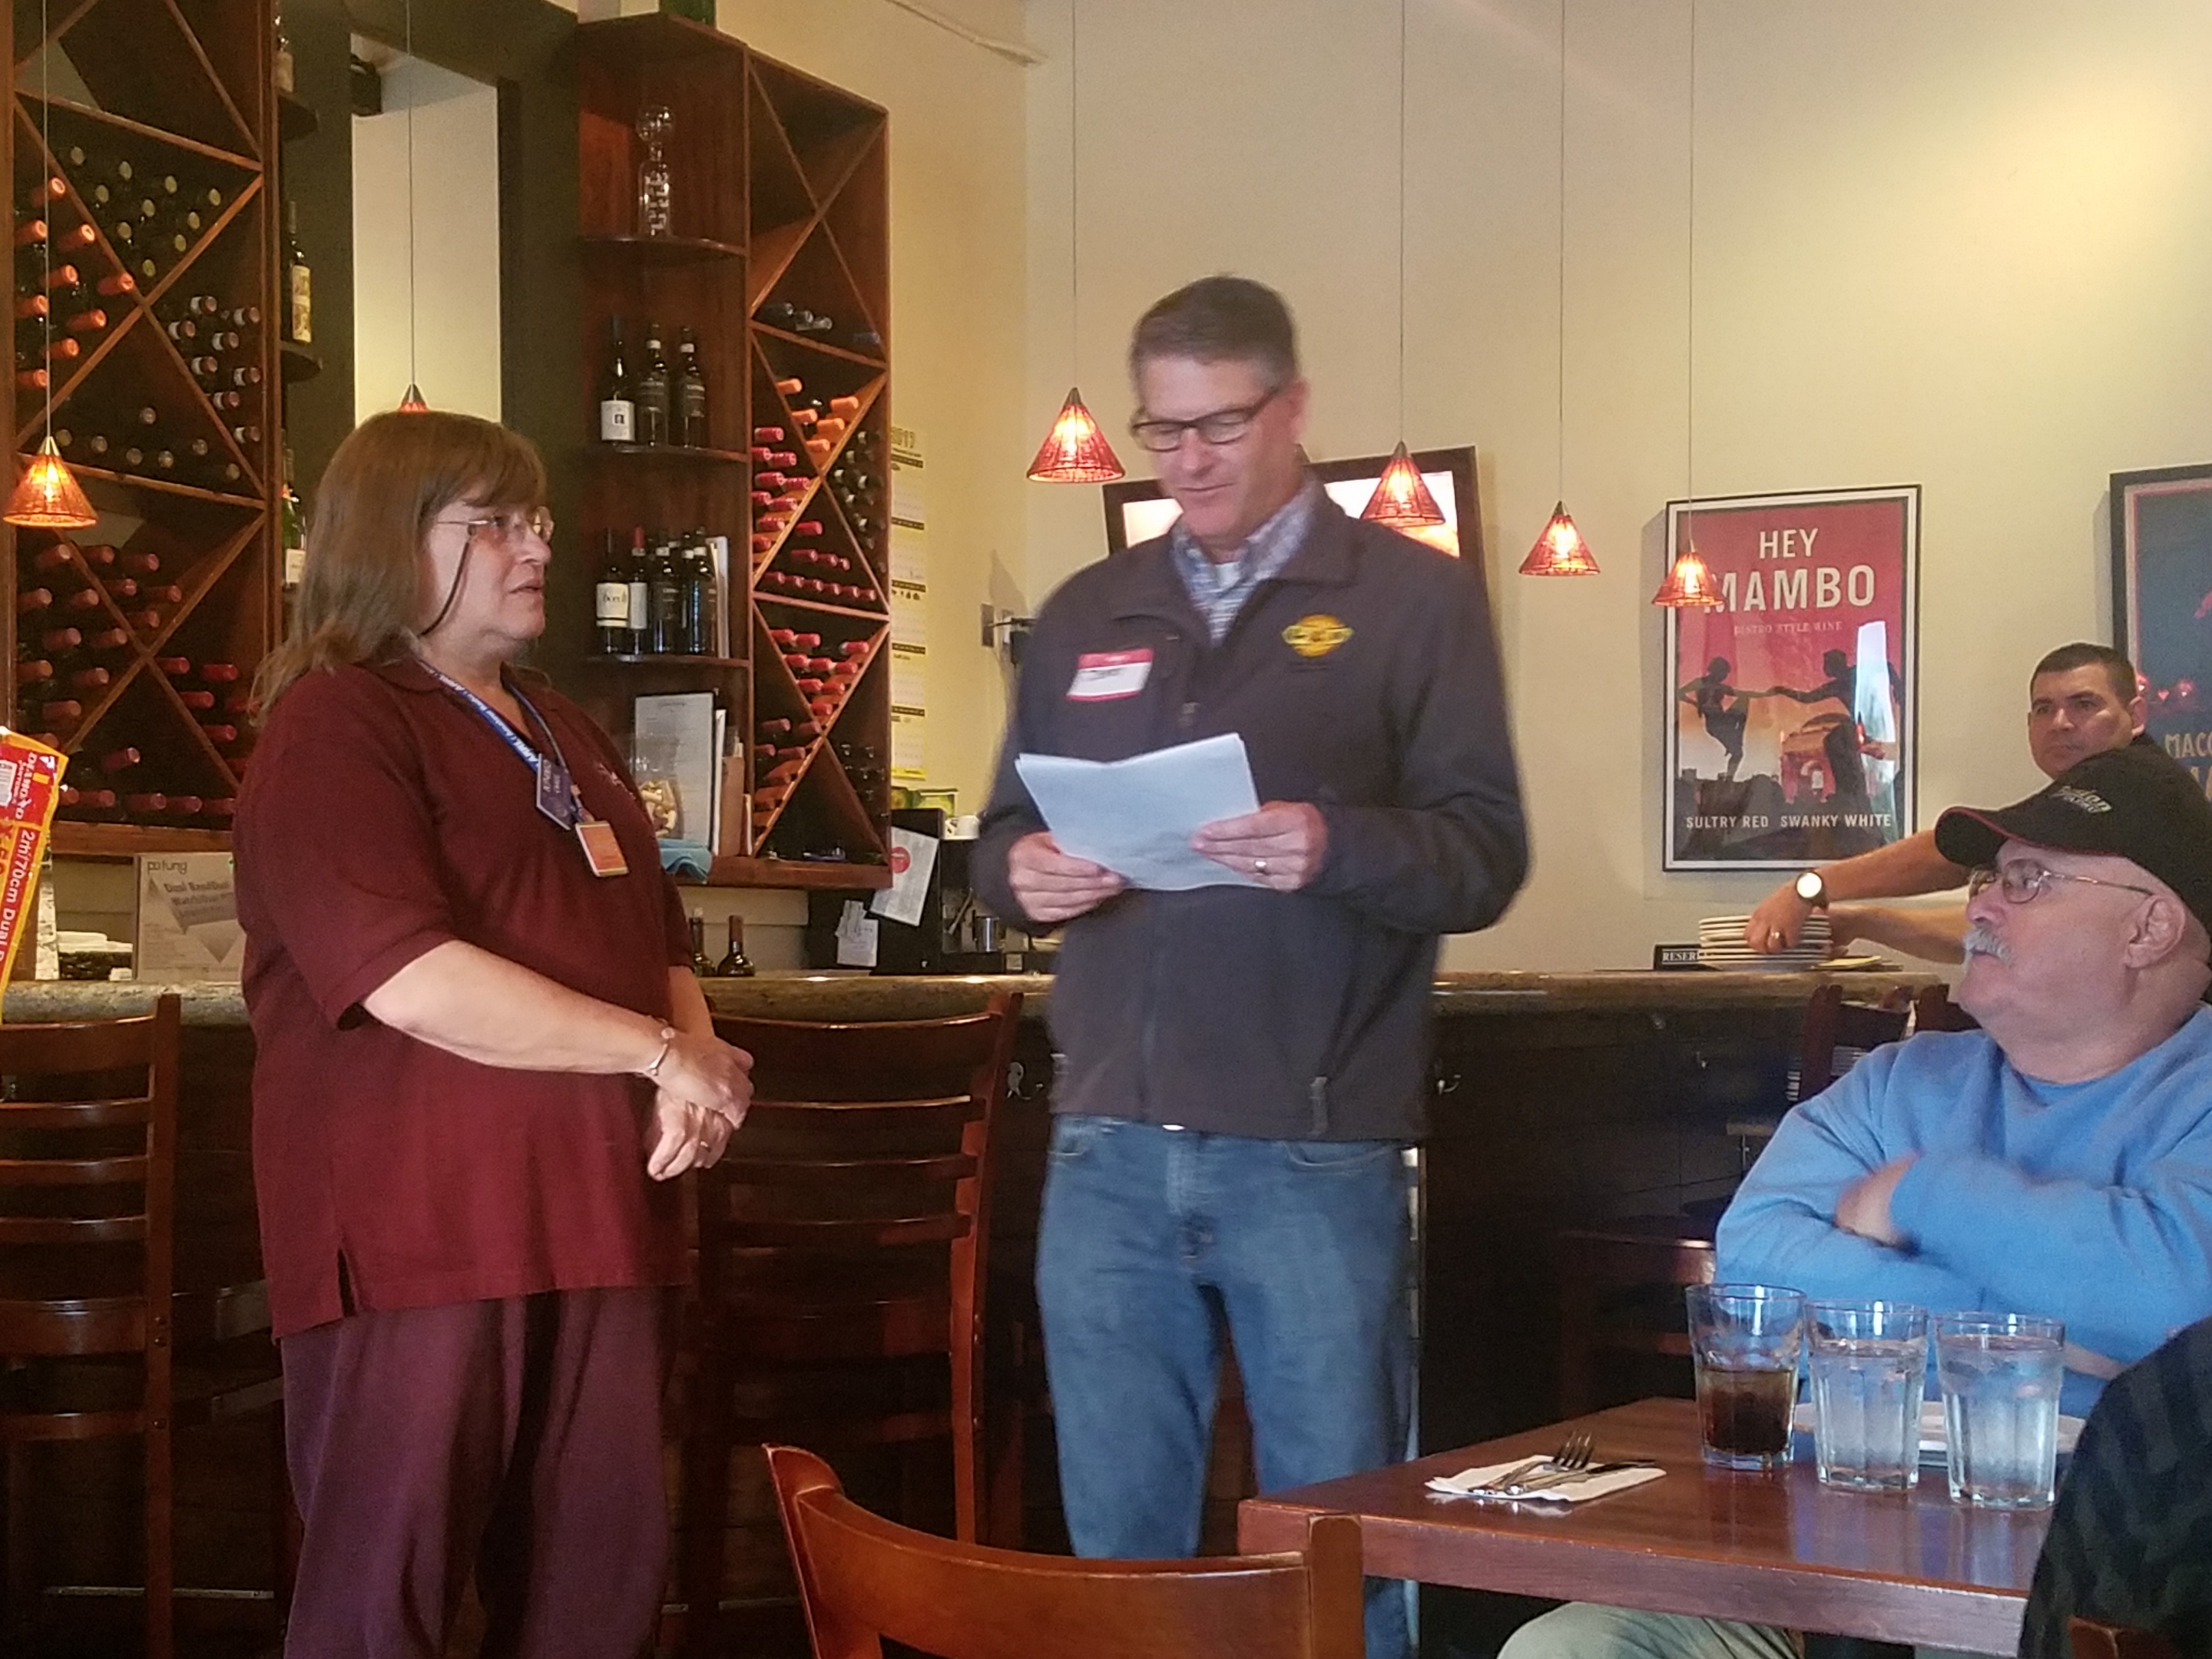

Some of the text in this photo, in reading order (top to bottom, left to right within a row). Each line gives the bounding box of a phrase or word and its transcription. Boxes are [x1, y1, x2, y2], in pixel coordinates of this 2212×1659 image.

[1759, 528, 1819, 559] HEY
[1704, 564, 1876, 614] MAMBO
[1734, 621, 1843, 636] BISTRO STYLE WINE
[1686, 813, 1892, 829] SULTRY RED SWANKY WHITE
[1662, 952, 1699, 962] RESER
